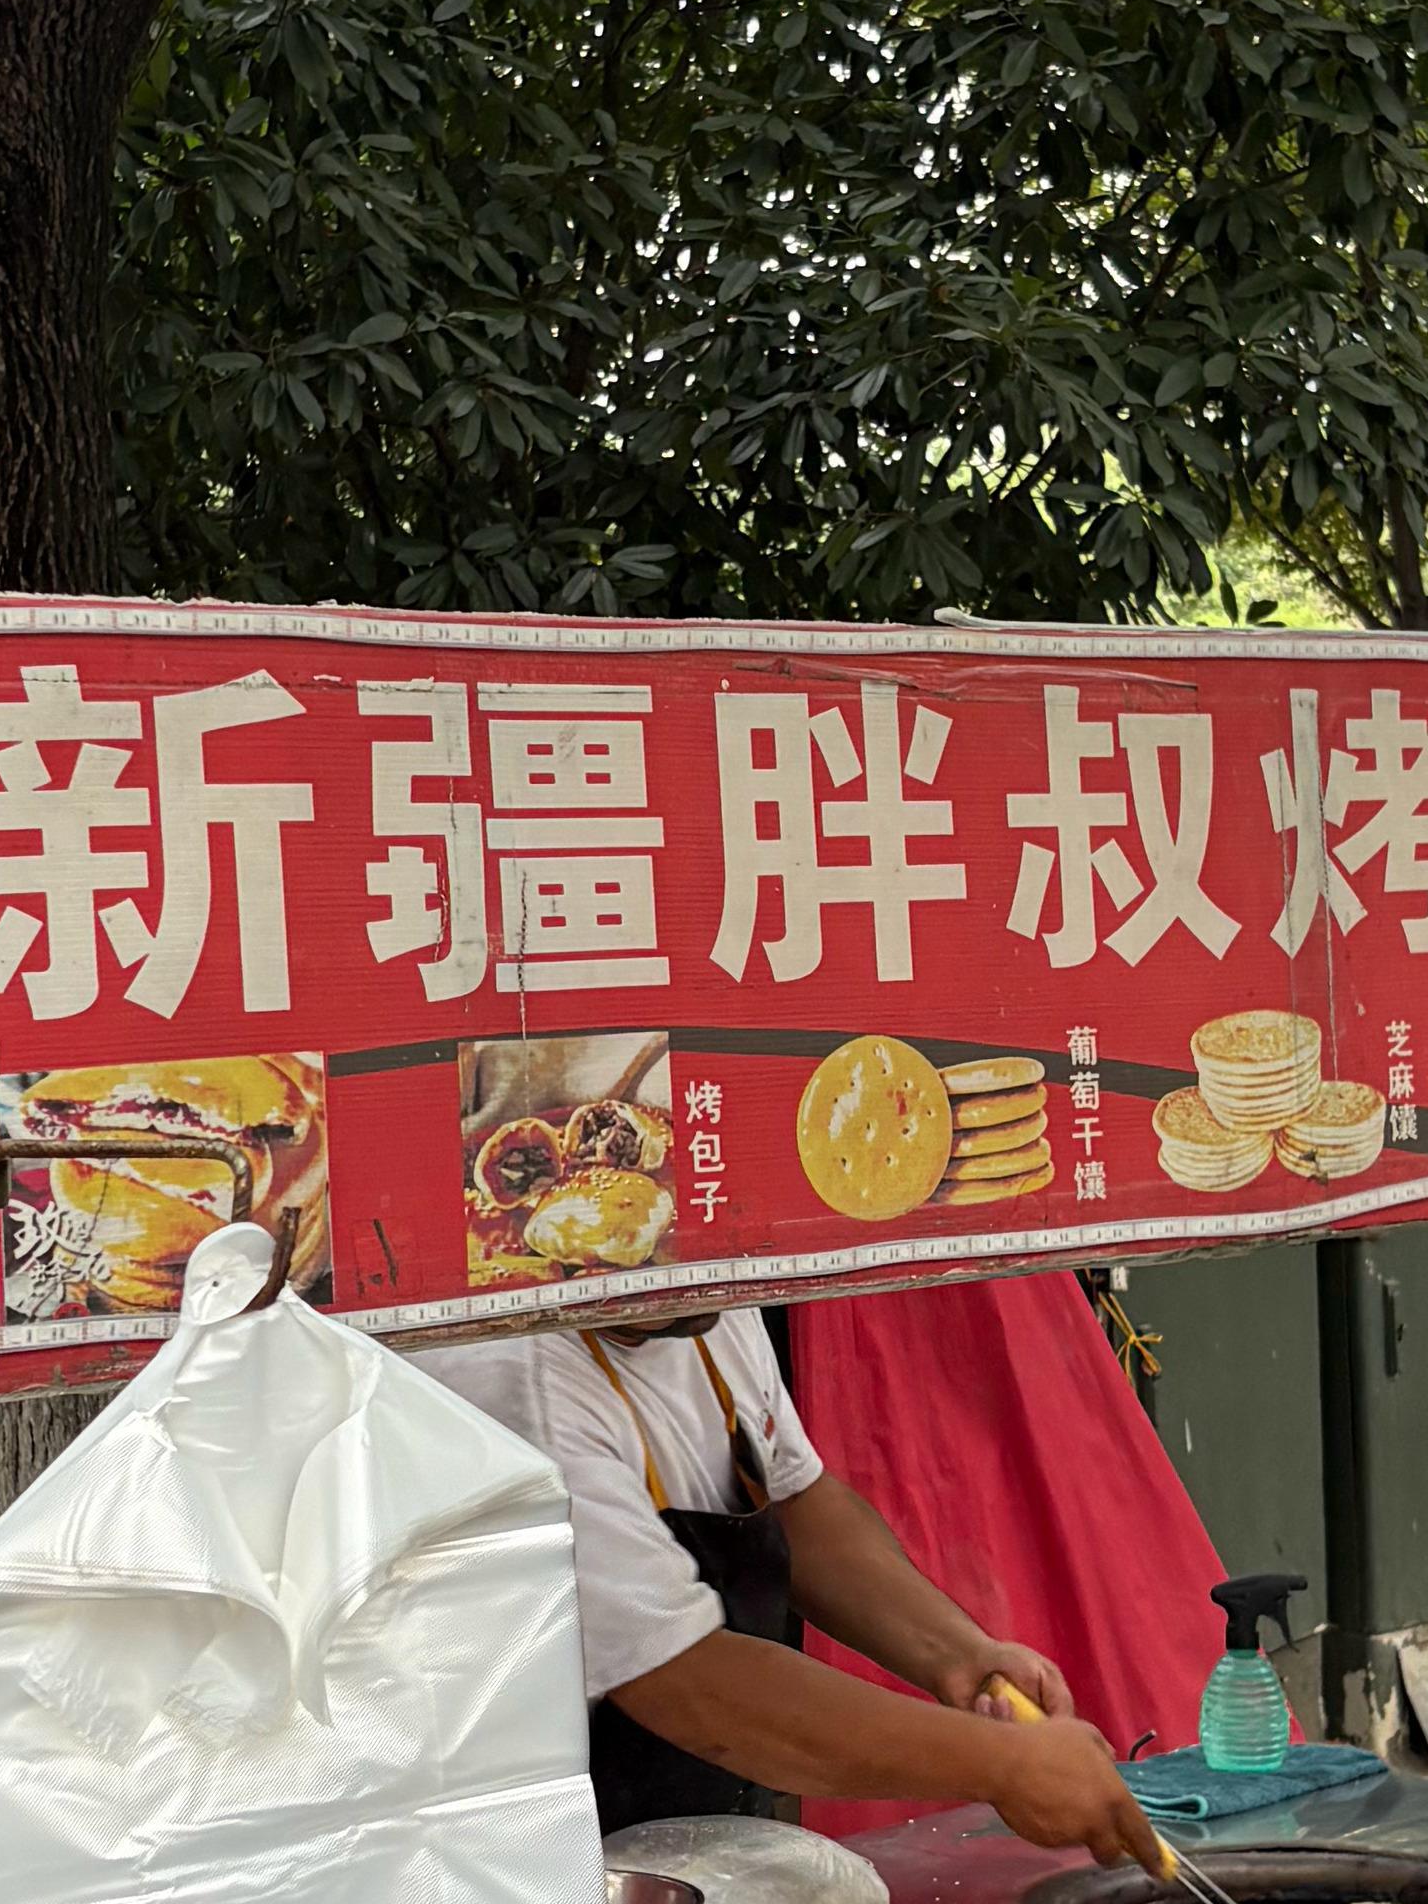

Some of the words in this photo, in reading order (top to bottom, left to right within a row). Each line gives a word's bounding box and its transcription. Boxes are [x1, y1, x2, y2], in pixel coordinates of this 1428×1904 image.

[684, 1080, 729, 1224] 烤包子
[1066, 1025, 1107, 1201] 葡萄干馕
[1384, 1020, 1419, 1142] 芝麻馕
